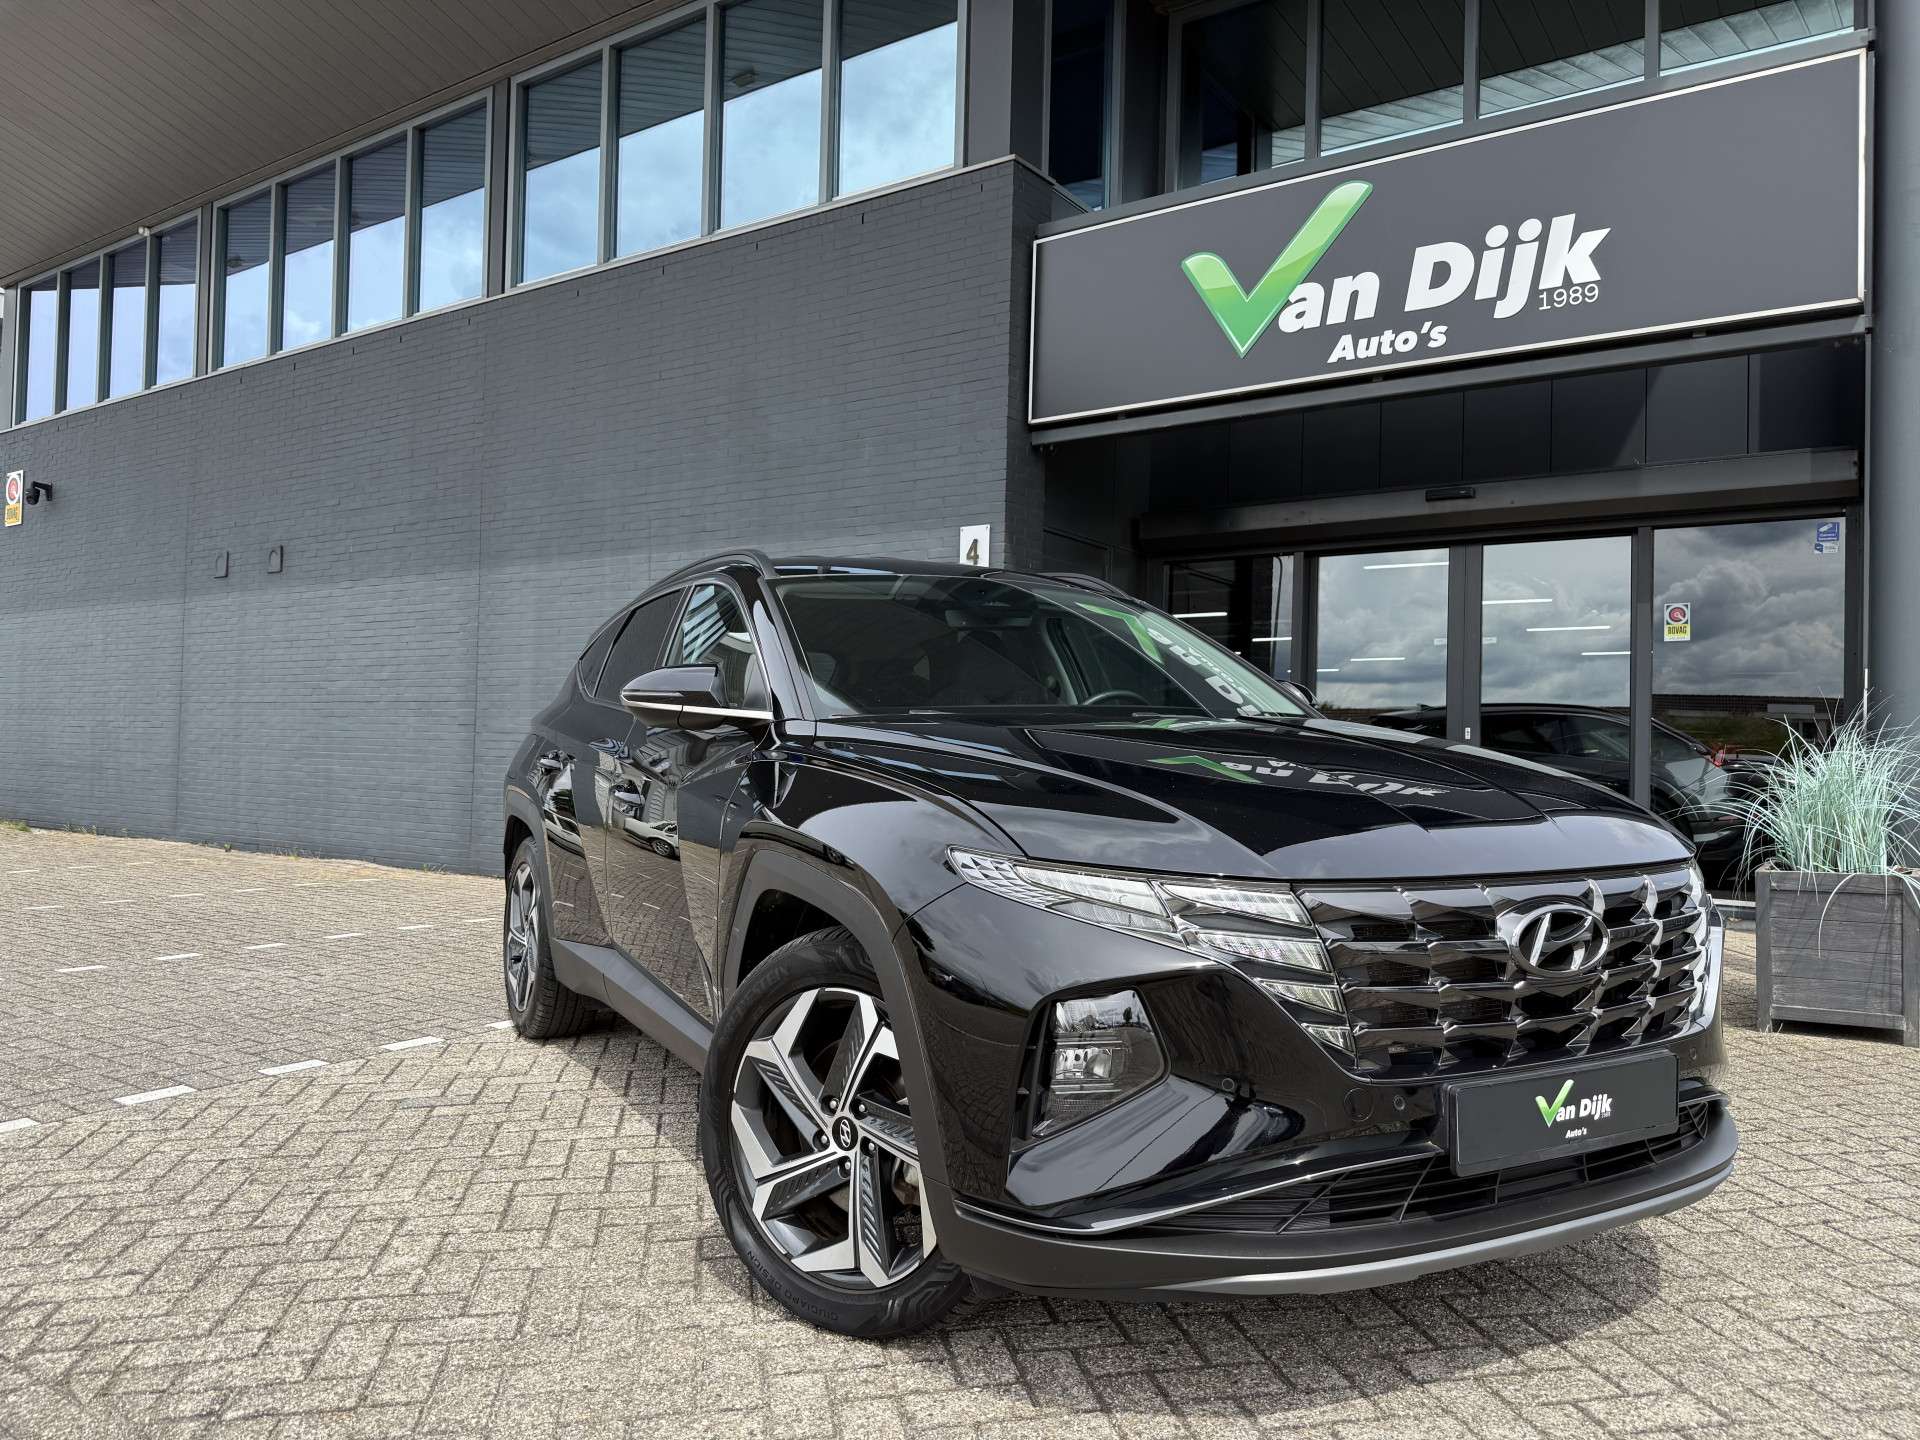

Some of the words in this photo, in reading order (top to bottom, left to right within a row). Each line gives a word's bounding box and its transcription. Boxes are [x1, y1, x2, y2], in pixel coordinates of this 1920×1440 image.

[1404, 213, 1611, 319] Dijk
[1538, 283, 1600, 310] 1989
[1326, 321, 1448, 363] Auto's
[966, 538, 979, 566] 4
[1667, 625, 1687, 636] BOVAG
[1579, 1094, 1613, 1120] Dijk
[1565, 1127, 1587, 1139] Auto's
